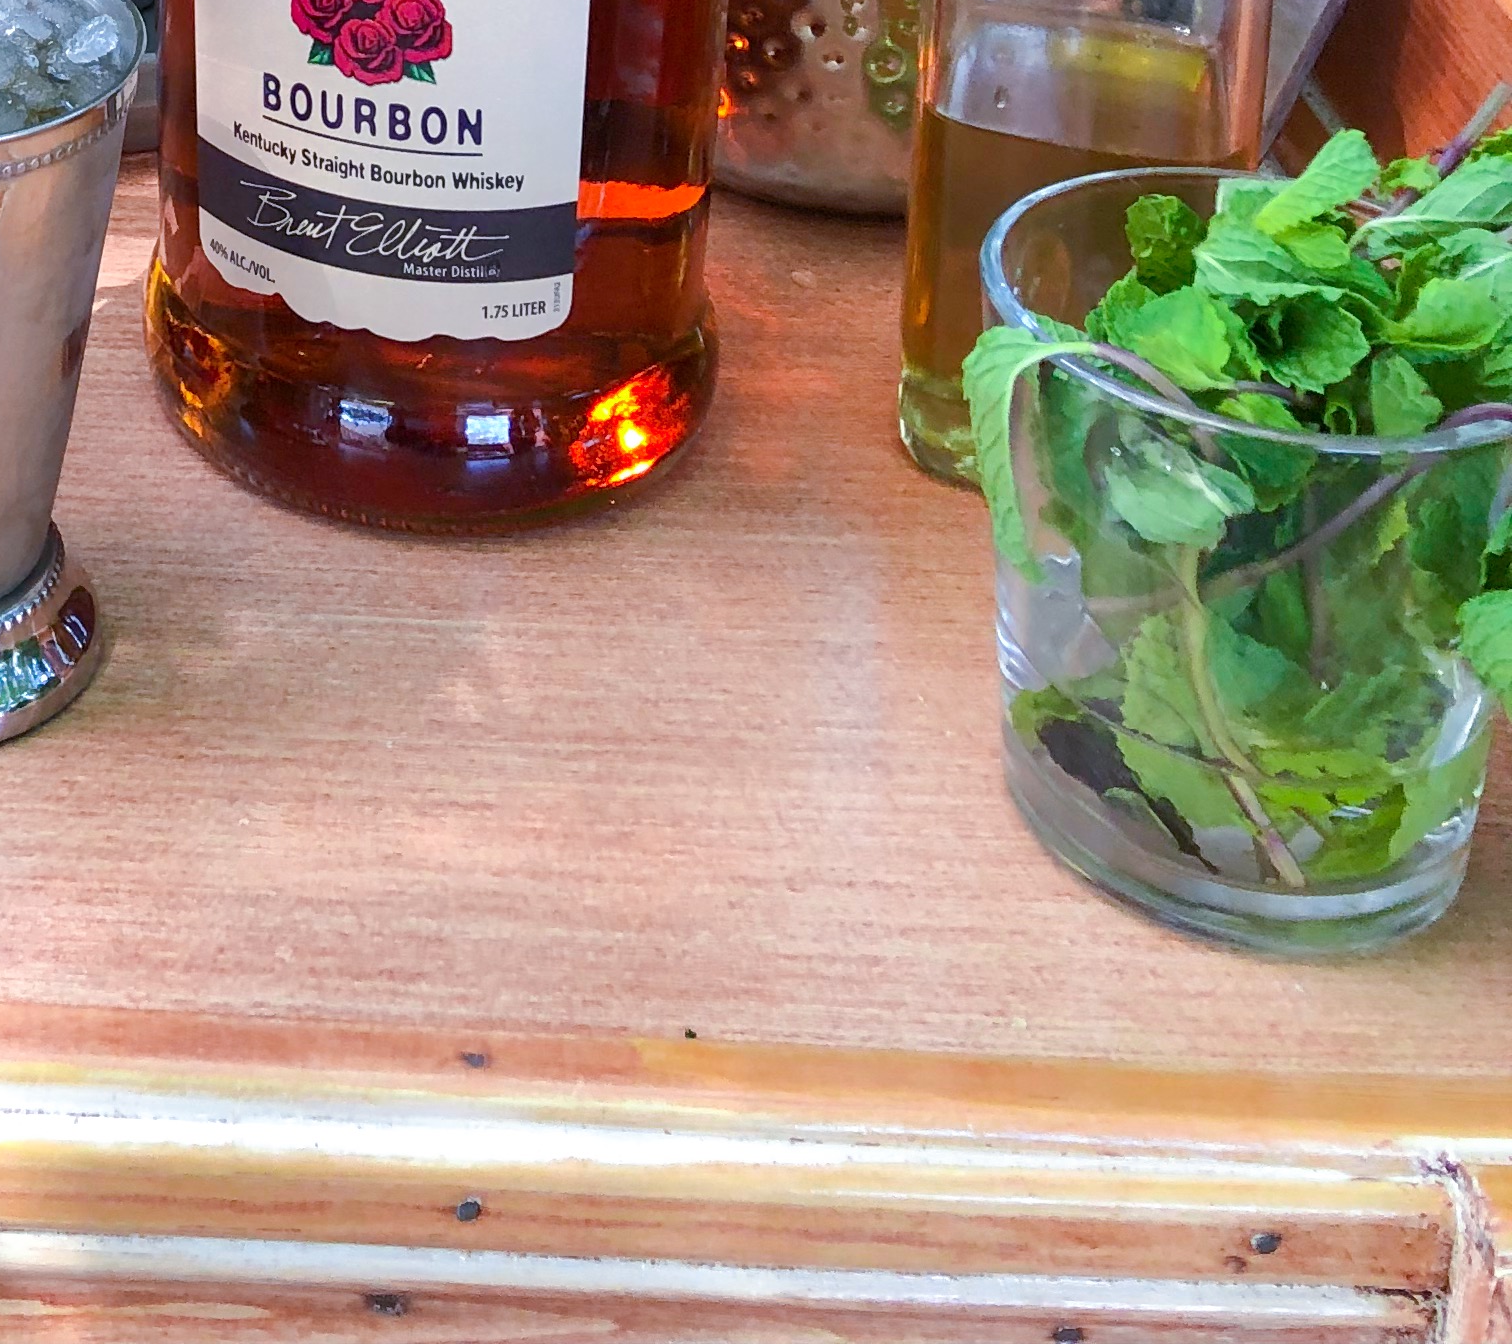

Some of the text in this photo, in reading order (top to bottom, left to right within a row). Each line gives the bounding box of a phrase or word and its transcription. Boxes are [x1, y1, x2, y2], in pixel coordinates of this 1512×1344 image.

[262, 72, 484, 146] BOURBON
[233, 120, 525, 192] Kentucky Straight Bourbon Whiskey
[239, 179, 510, 263] Brent Elliott
[403, 262, 448, 277] Master
[481, 300, 547, 319] 1.75 LITER
